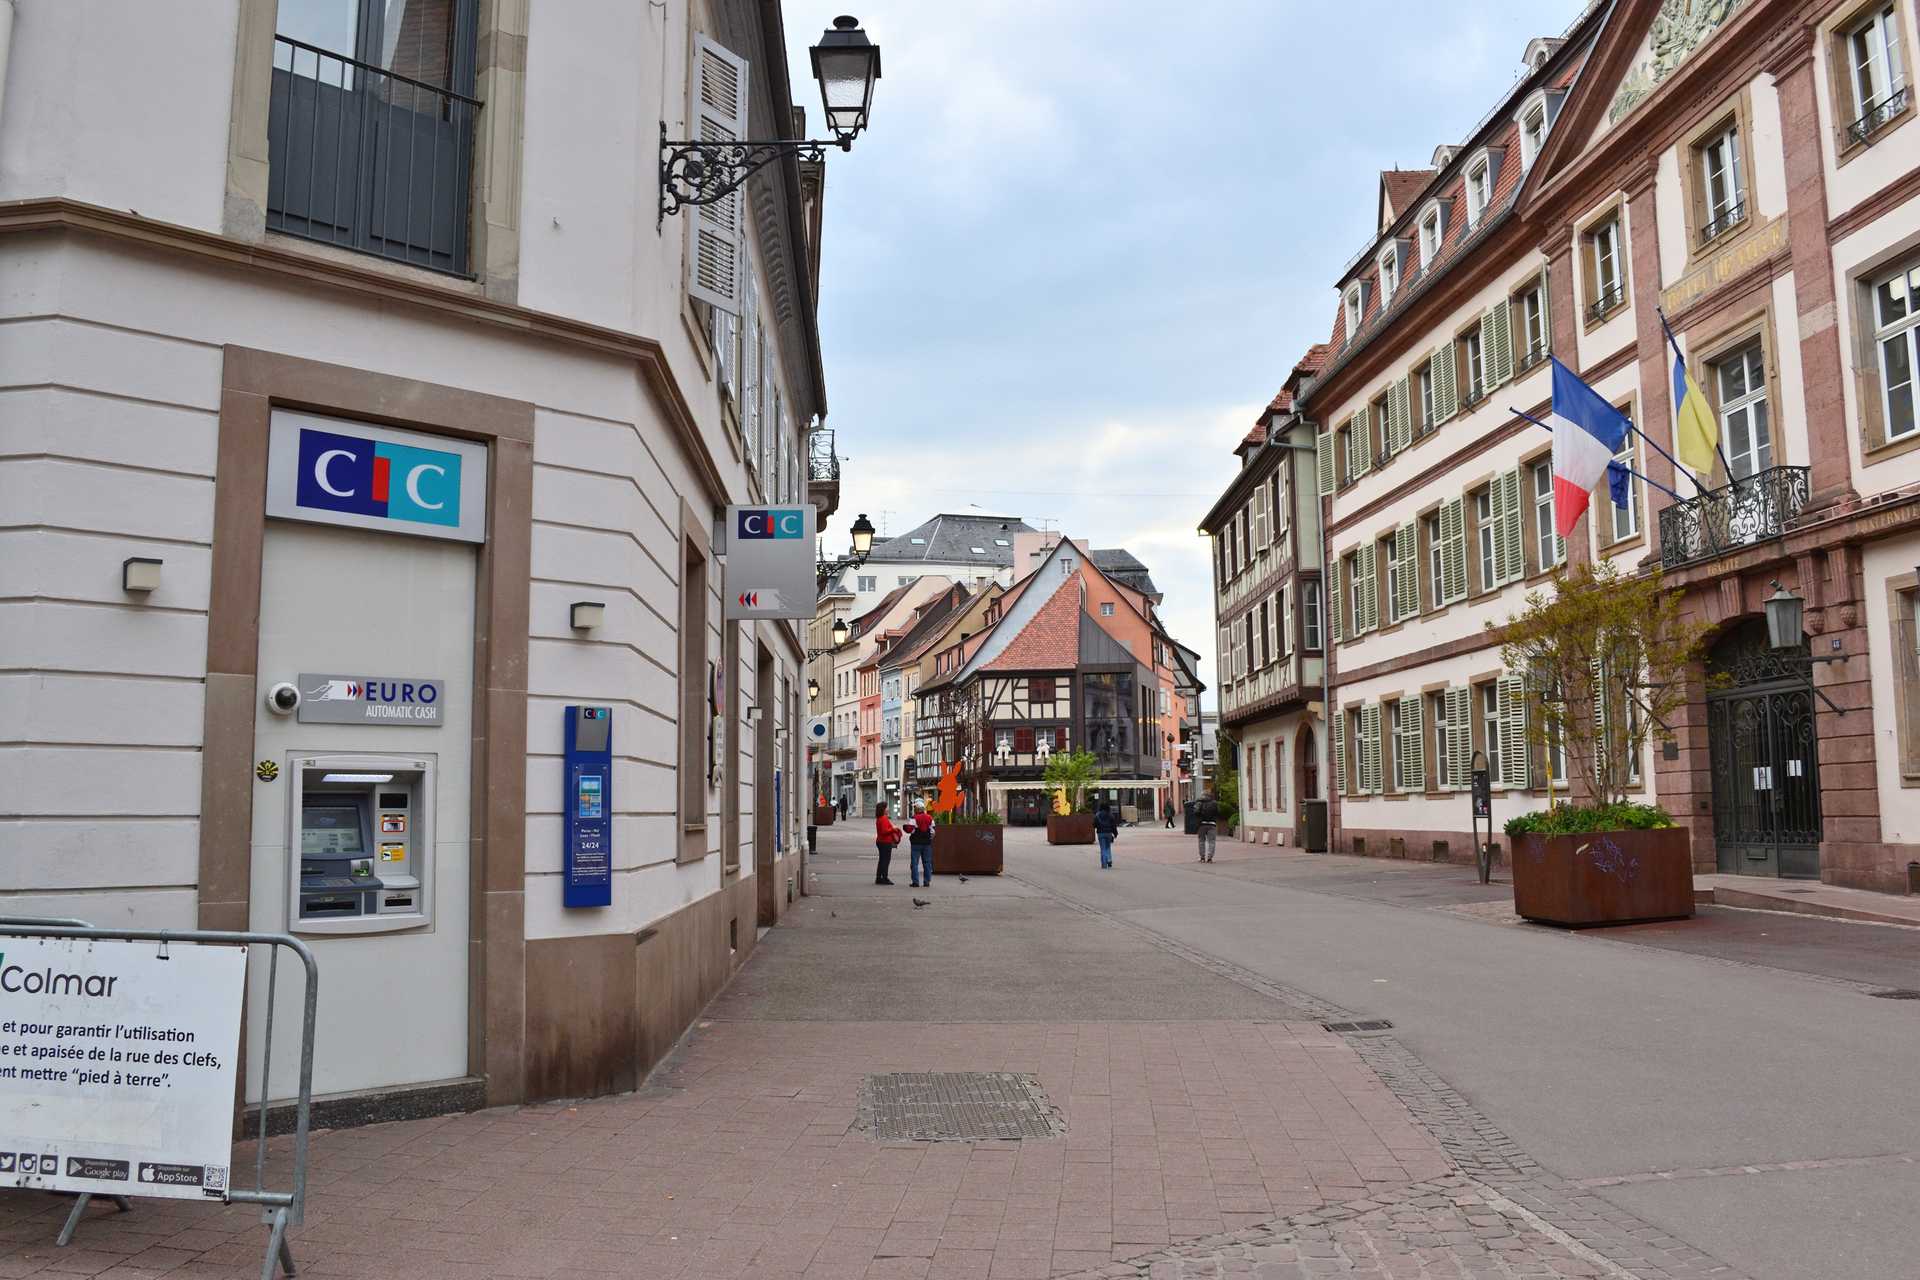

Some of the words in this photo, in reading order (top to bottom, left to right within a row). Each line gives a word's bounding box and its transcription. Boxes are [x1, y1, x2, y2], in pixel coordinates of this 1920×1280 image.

[314, 449, 446, 510] CIC
[744, 515, 798, 534] CIC
[365, 682, 437, 704] EURO
[366, 705, 414, 718] AUTOMATIC
[415, 706, 437, 719] CASH
[585, 709, 605, 718] CIC
[1, 965, 118, 998] Colmar
[3, 1020, 16, 1033] et
[20, 1023, 53, 1037] pour
[56, 1024, 112, 1039] garantir
[115, 1024, 195, 1043] l’utilisation
[13, 1044, 27, 1056] et
[31, 1045, 84, 1061] apaisée
[88, 1046, 106, 1061] de
[110, 1047, 122, 1062] la
[126, 1051, 150, 1064] rue
[154, 1050, 179, 1065] des
[183, 1051, 221, 1070] Clefs,
[0, 1066, 17, 1079] nt
[21, 1067, 68, 1082] mettre
[72, 1067, 110, 1086] “pied
[113, 1070, 121, 1085] à
[126, 1072, 171, 1088] terre”.
[84, 1166, 112, 1179] Google
[112, 1168, 128, 1180] play
